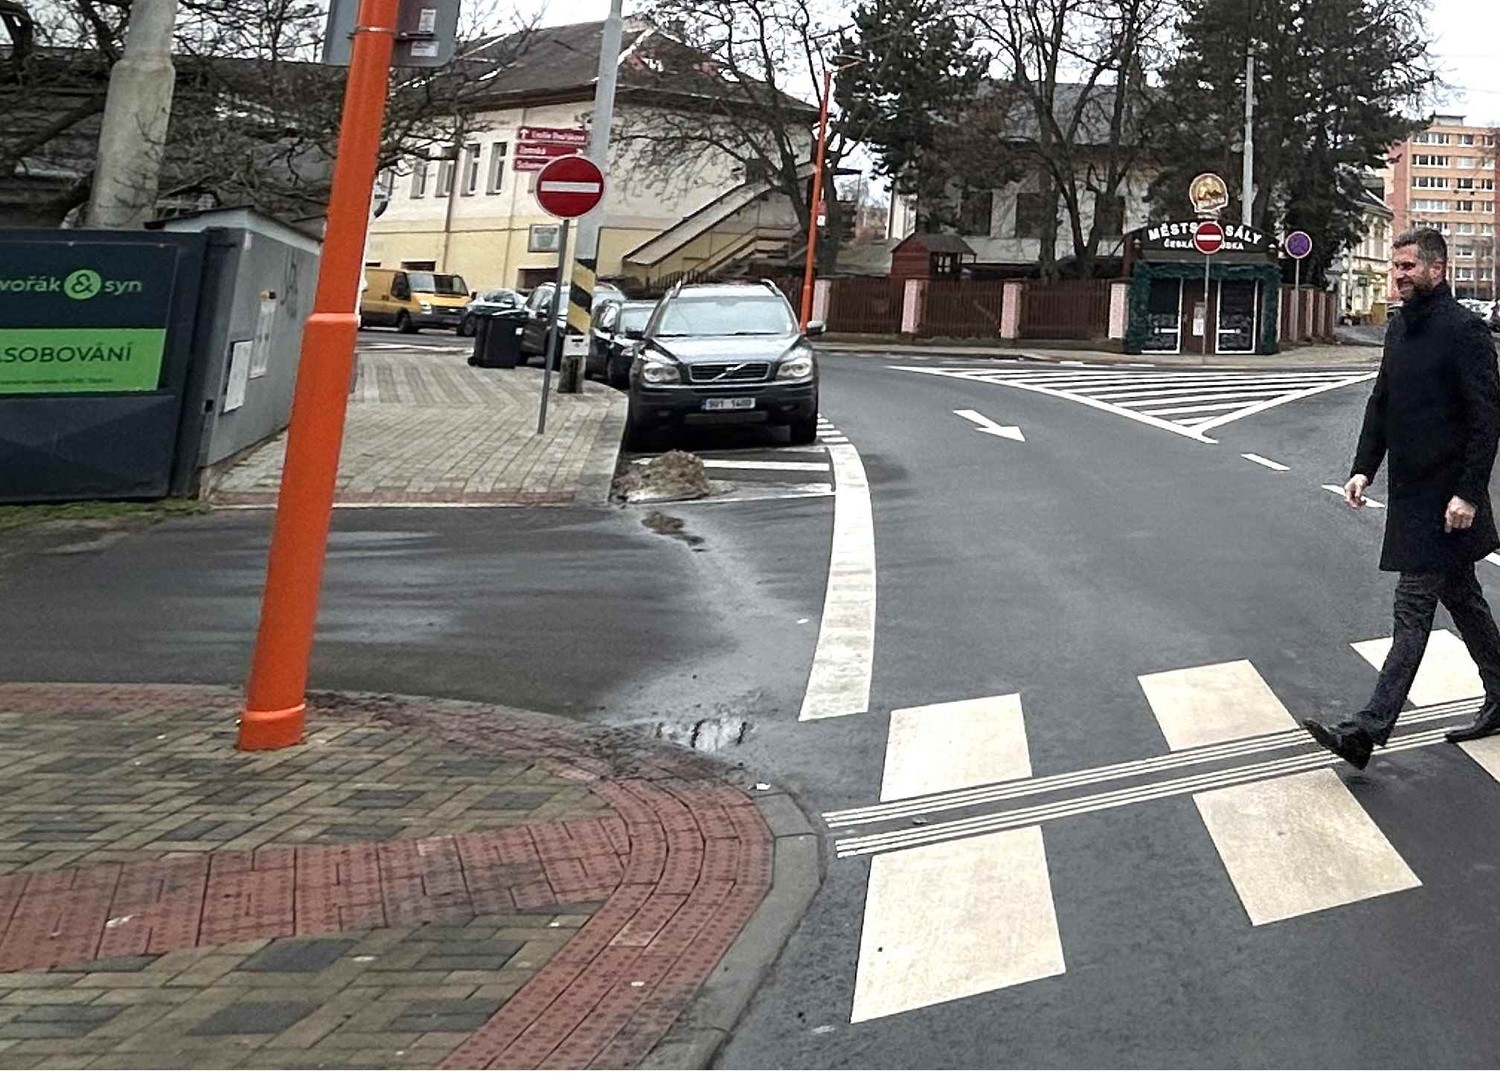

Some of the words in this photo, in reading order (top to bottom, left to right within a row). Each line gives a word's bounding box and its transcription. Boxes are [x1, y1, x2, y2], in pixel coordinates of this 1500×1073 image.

[1225, 225, 1262, 244] SÁLY
[104, 280, 142, 296] syn
[0, 341, 134, 364] SOBOVÁNÍ
